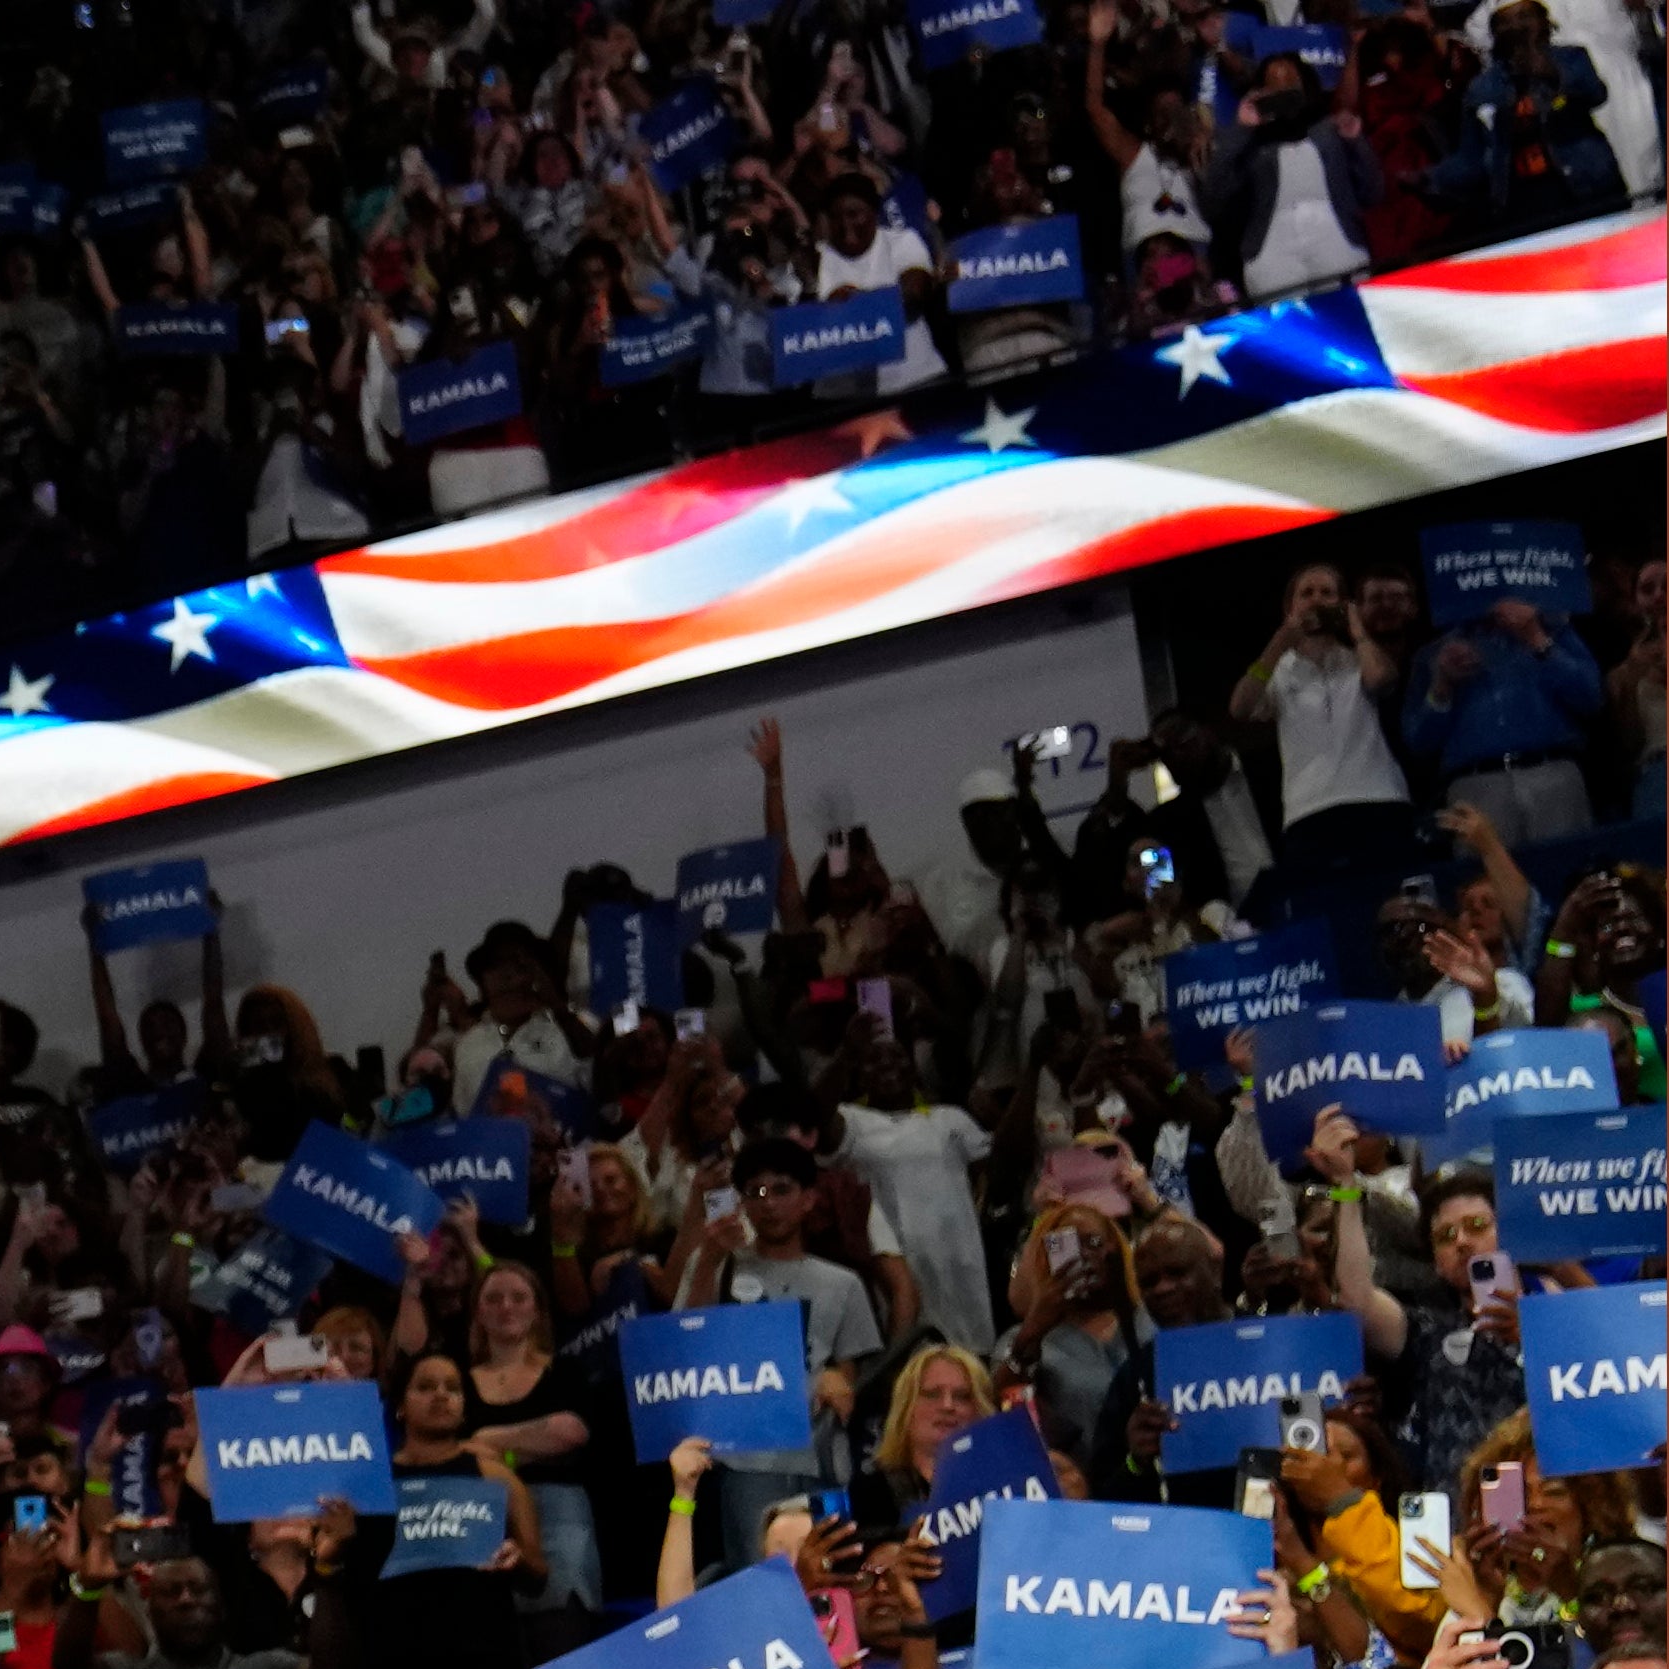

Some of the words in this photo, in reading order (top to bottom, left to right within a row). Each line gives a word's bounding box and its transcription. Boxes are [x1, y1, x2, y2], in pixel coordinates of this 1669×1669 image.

[957, 249, 1068, 281] KAMALA
[783, 319, 892, 355] KAMALA
[409, 373, 507, 414] KAMALA
[1457, 571, 1497, 590] WE
[624, 913, 647, 1003] AMALA
[1176, 978, 1246, 1009] When
[1239, 974, 1270, 997] we
[1270, 963, 1326, 992] fight,
[1196, 1004, 1239, 1032] WE
[1245, 995, 1309, 1022] WIN.
[1265, 1052, 1424, 1102] KAMALA
[1511, 1157, 1591, 1185] When
[1597, 1158, 1636, 1180] we
[295, 1164, 414, 1233] KAMALA
[1539, 1188, 1598, 1216] WE
[634, 1360, 784, 1405] KAMALA
[1172, 1370, 1344, 1418] KAMALA
[1549, 1354, 1668, 1402] KAM
[218, 1432, 372, 1469] KAMALA
[399, 1506, 430, 1520] we
[426, 1500, 493, 1523] fight,
[401, 1518, 468, 1540] WIN.
[918, 1476, 1048, 1546] KAMA
[1005, 1574, 1243, 1625] KAMALA
